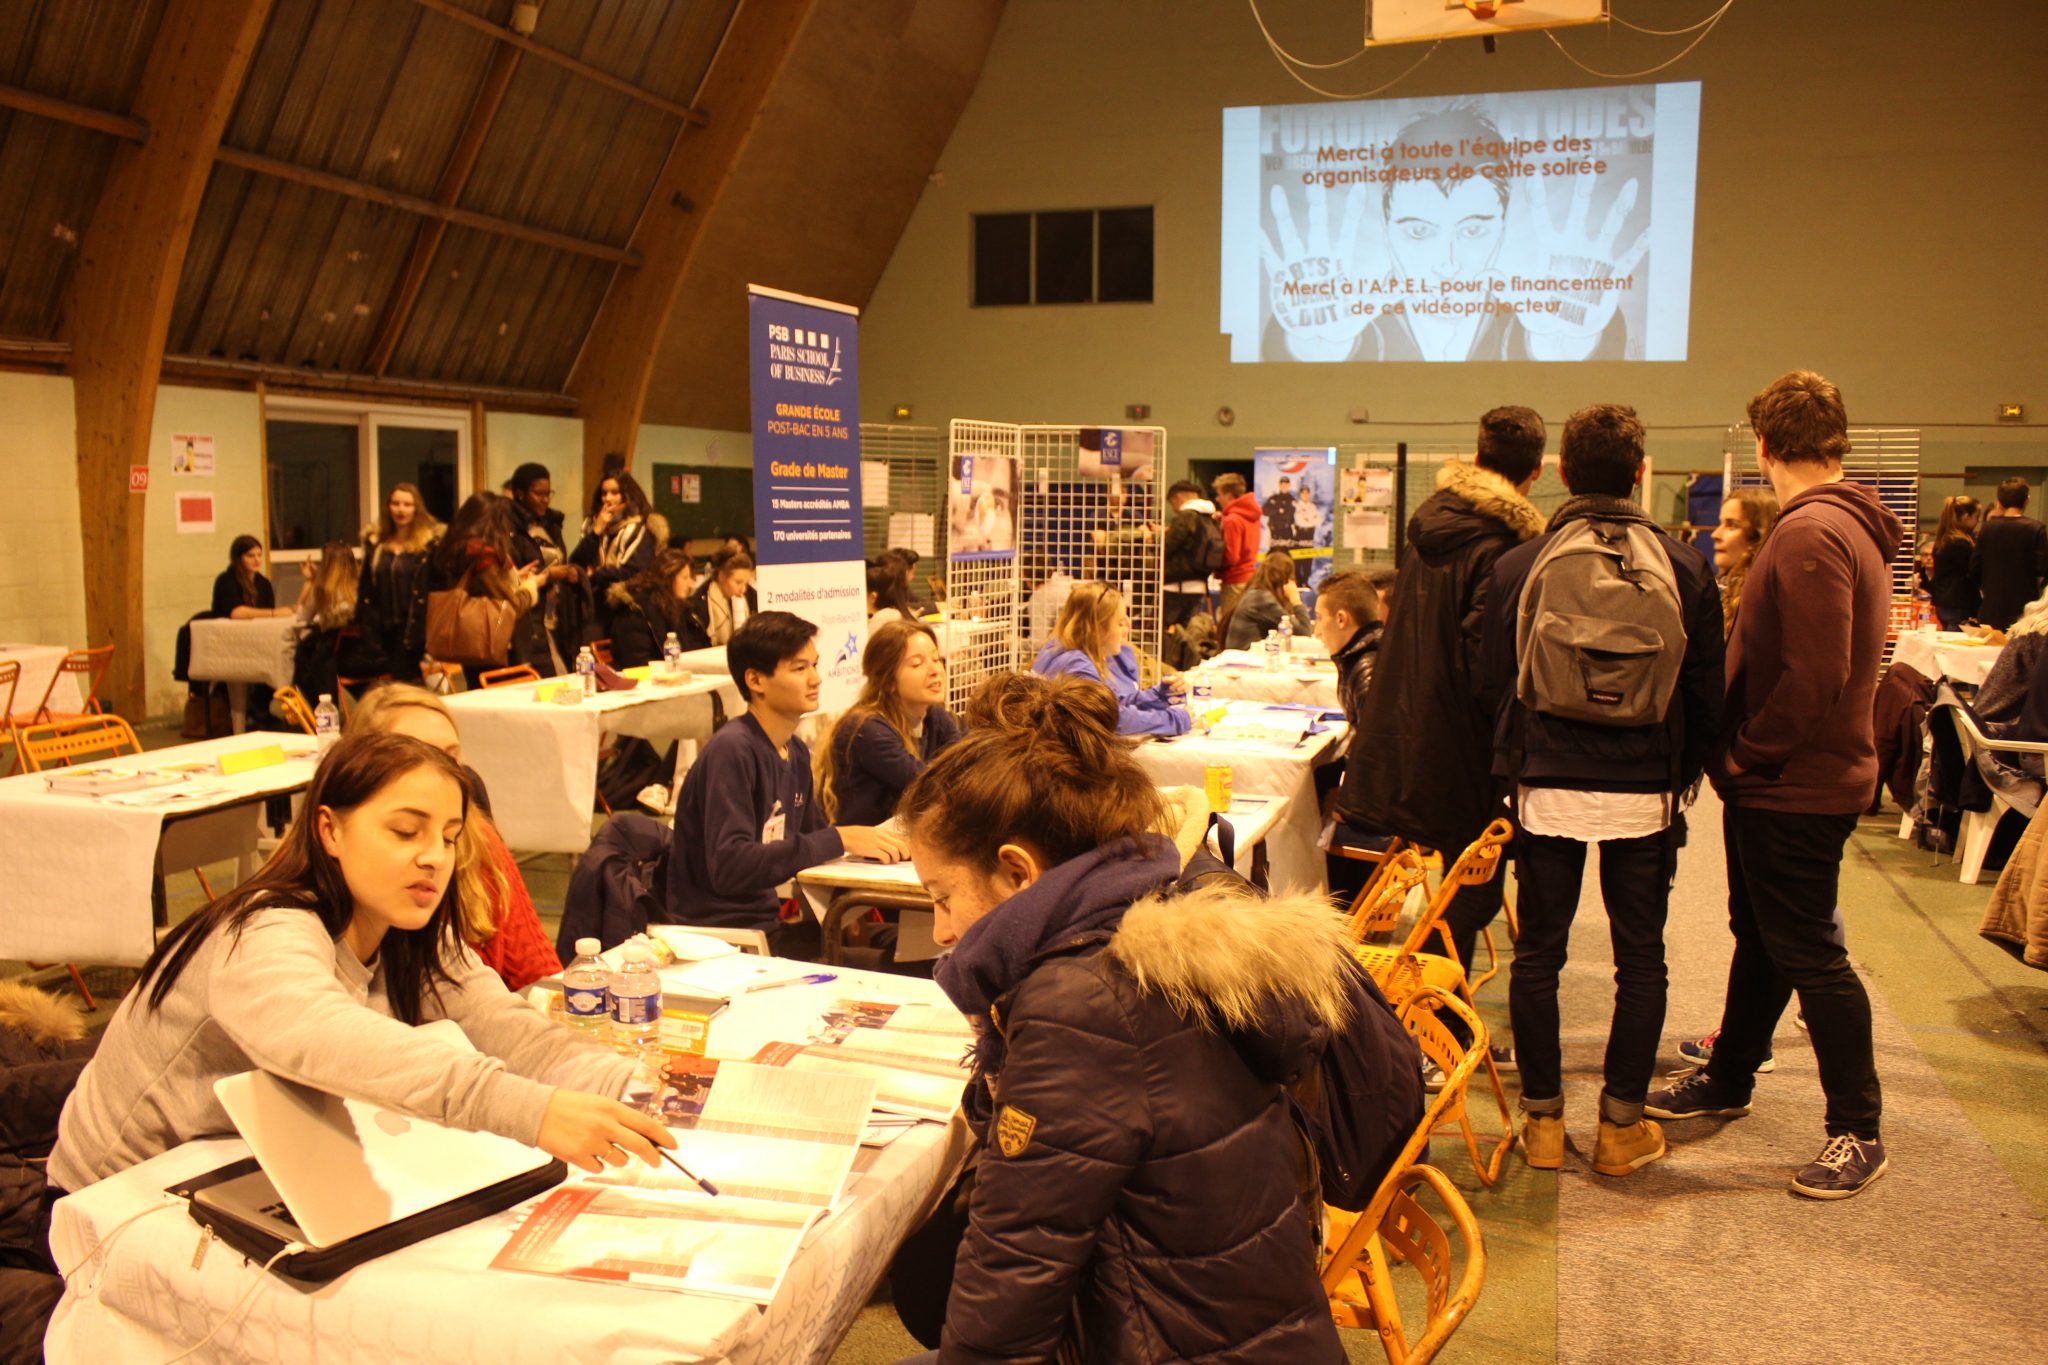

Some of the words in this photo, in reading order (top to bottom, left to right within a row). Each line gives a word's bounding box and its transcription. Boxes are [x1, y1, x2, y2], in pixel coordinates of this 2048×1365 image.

[1317, 144, 1375, 162] Merci
[1381, 141, 1394, 160] à
[1401, 141, 1453, 159] toute
[1459, 138, 1547, 158] l'équipe
[1553, 135, 1592, 153] des
[1302, 165, 1441, 188] organisateurs
[1446, 162, 1475, 180] de
[1481, 159, 1536, 179] cette
[1542, 155, 1608, 176] soirée
[1283, 279, 1336, 296] Merci
[1341, 278, 1353, 294] à
[1440, 279, 1483, 295] pour
[1489, 277, 1506, 292] le
[1511, 274, 1633, 292] financement
[1350, 300, 1375, 315] de
[1382, 303, 1405, 315] ce
[1412, 298, 1563, 317] vidéoprojecteur
[769, 324, 790, 342] PSB
[770, 343, 796, 361] PARIS
[796, 347, 829, 367] SCHOOL
[770, 362, 783, 379] OF
[784, 364, 827, 384] BUSINESS
[776, 402, 812, 419] GRANDE
[813, 404, 840, 422] ÉCOLE
[768, 420, 810, 436] POST-BAC
[811, 423, 823, 438] EN
[825, 425, 830, 438] 5
[831, 426, 849, 440] ANS
[131, 472, 147, 486] 09
[770, 460, 801, 477] Grade
[803, 462, 816, 478] de
[817, 463, 849, 479] Master
[803, 498, 832, 509] accrédités
[773, 530, 785, 541] 170
[785, 529, 818, 541] universités
[818, 529, 852, 542] partenaires
[767, 591, 773, 604] 2
[775, 589, 815, 603] modalités
[816, 587, 860, 600] d'admission
